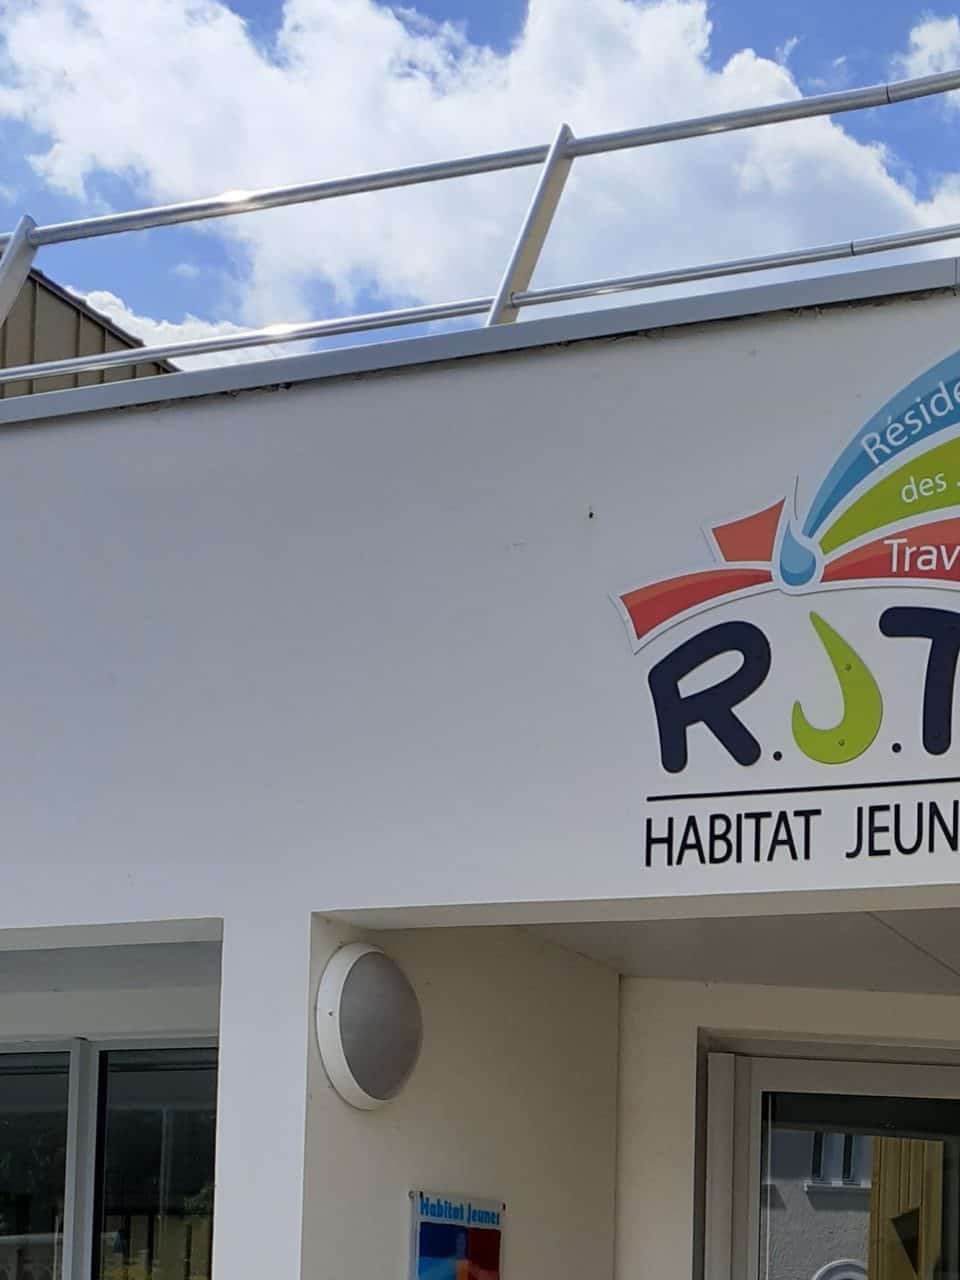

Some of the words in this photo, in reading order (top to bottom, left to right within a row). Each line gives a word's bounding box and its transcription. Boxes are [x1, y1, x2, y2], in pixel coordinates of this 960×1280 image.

[900, 468, 948, 504] des
[644, 808, 822, 868] HABITAT
[419, 1197, 465, 1221] Habitat
